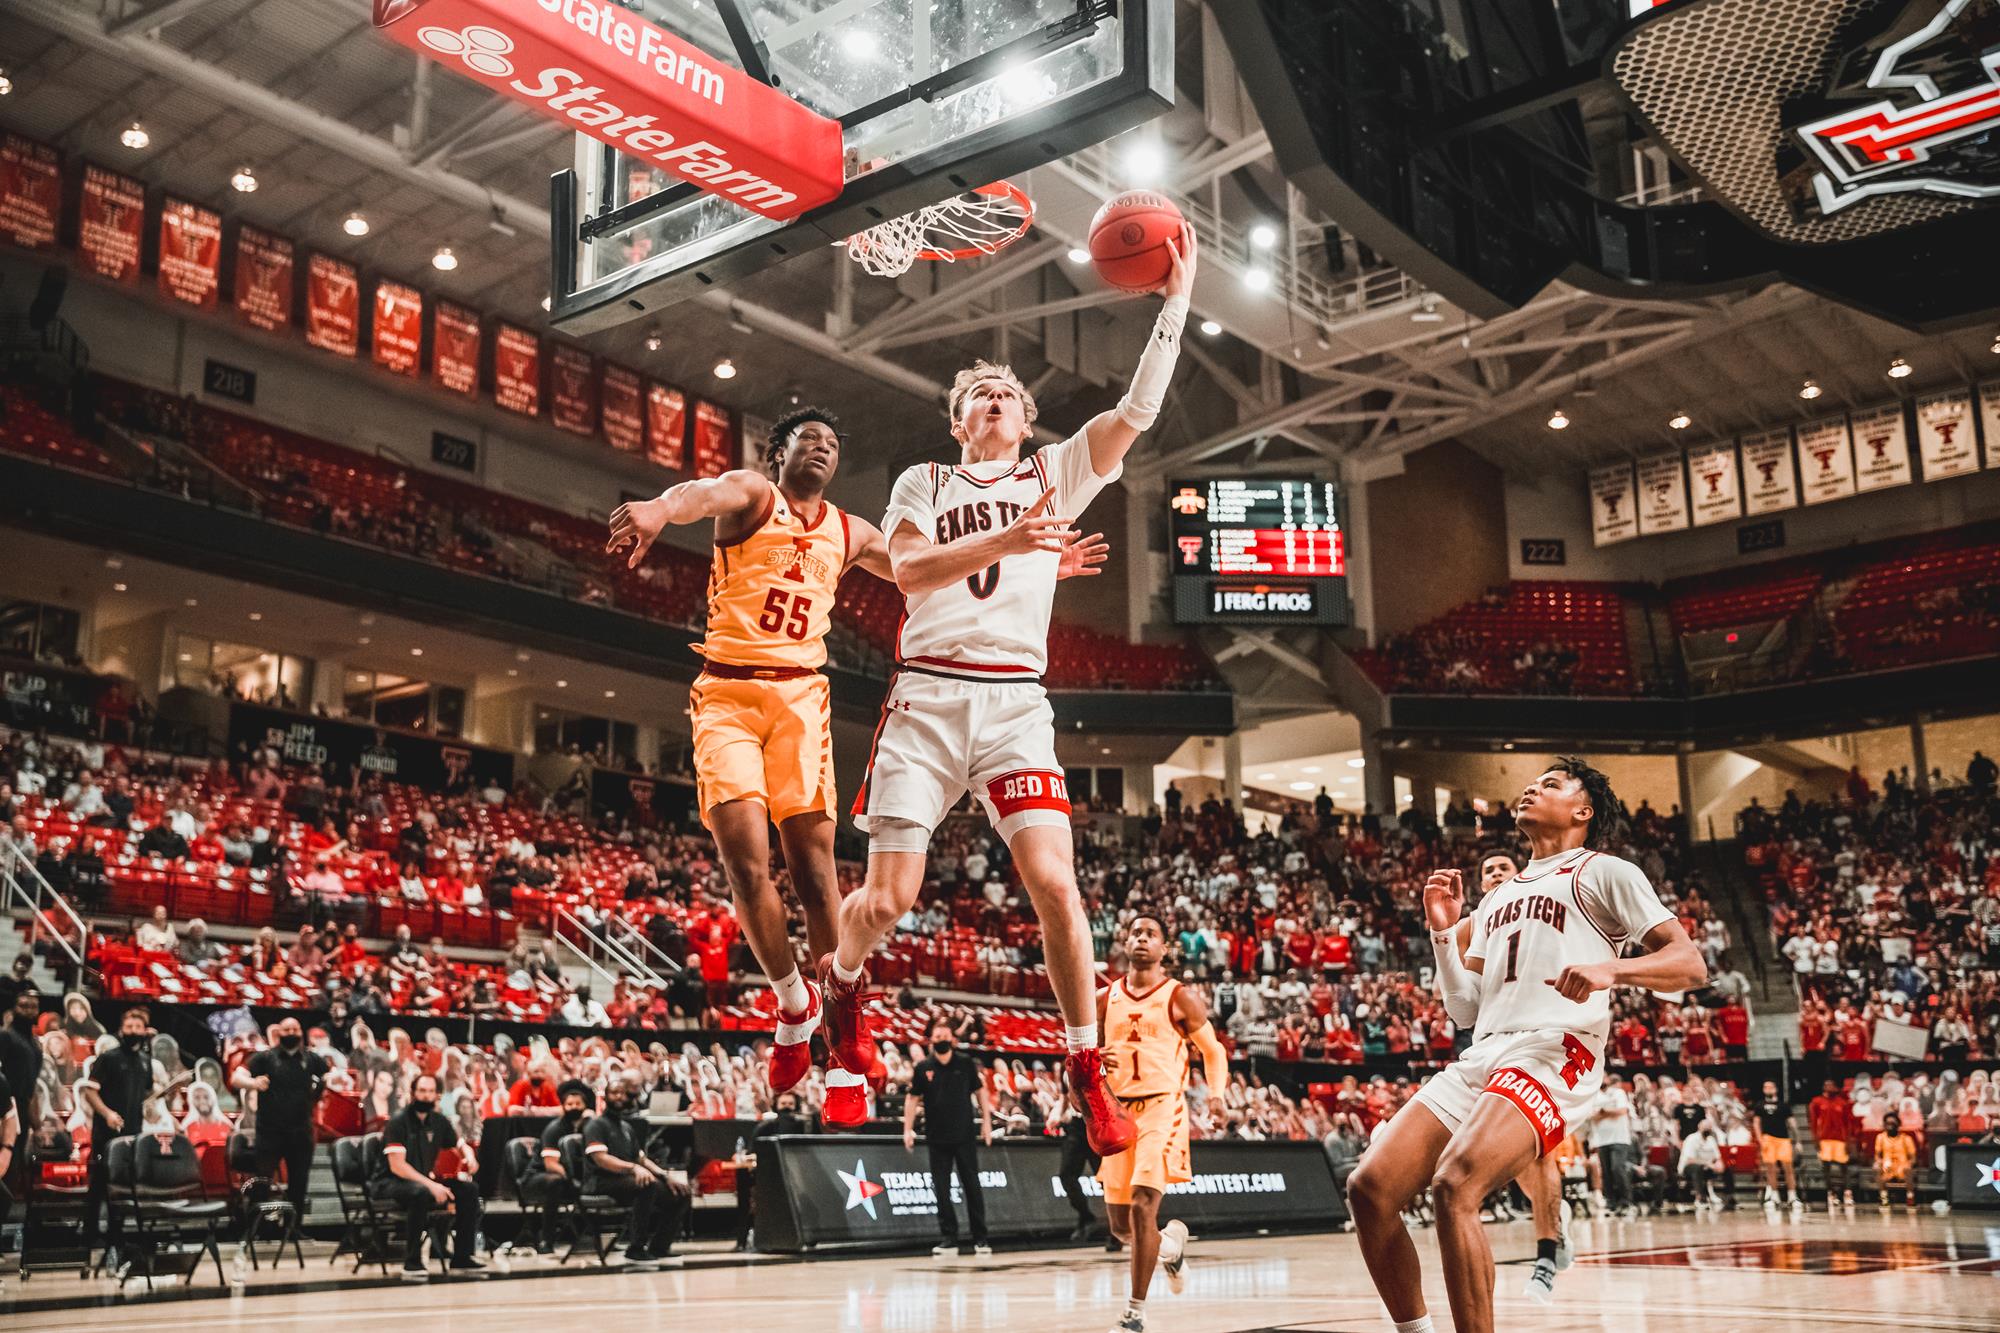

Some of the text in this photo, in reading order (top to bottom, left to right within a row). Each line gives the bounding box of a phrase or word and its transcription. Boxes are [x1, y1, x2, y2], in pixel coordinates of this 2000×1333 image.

[936, 500, 992, 546] EXAS
[765, 548, 829, 581] STATE
[1525, 544, 1564, 565] 222
[759, 586, 813, 641] 55
[1213, 592, 1312, 613] J FERG PROS
[287, 722, 316, 744] JIM
[1004, 776, 1043, 800] RED
[1526, 895, 1567, 934] TECH
[1504, 929, 1522, 983] 1
[1131, 1050, 1141, 1081] 1
[1500, 1071, 1560, 1136] RAIDERS
[880, 1172, 925, 1189] TEXAS
